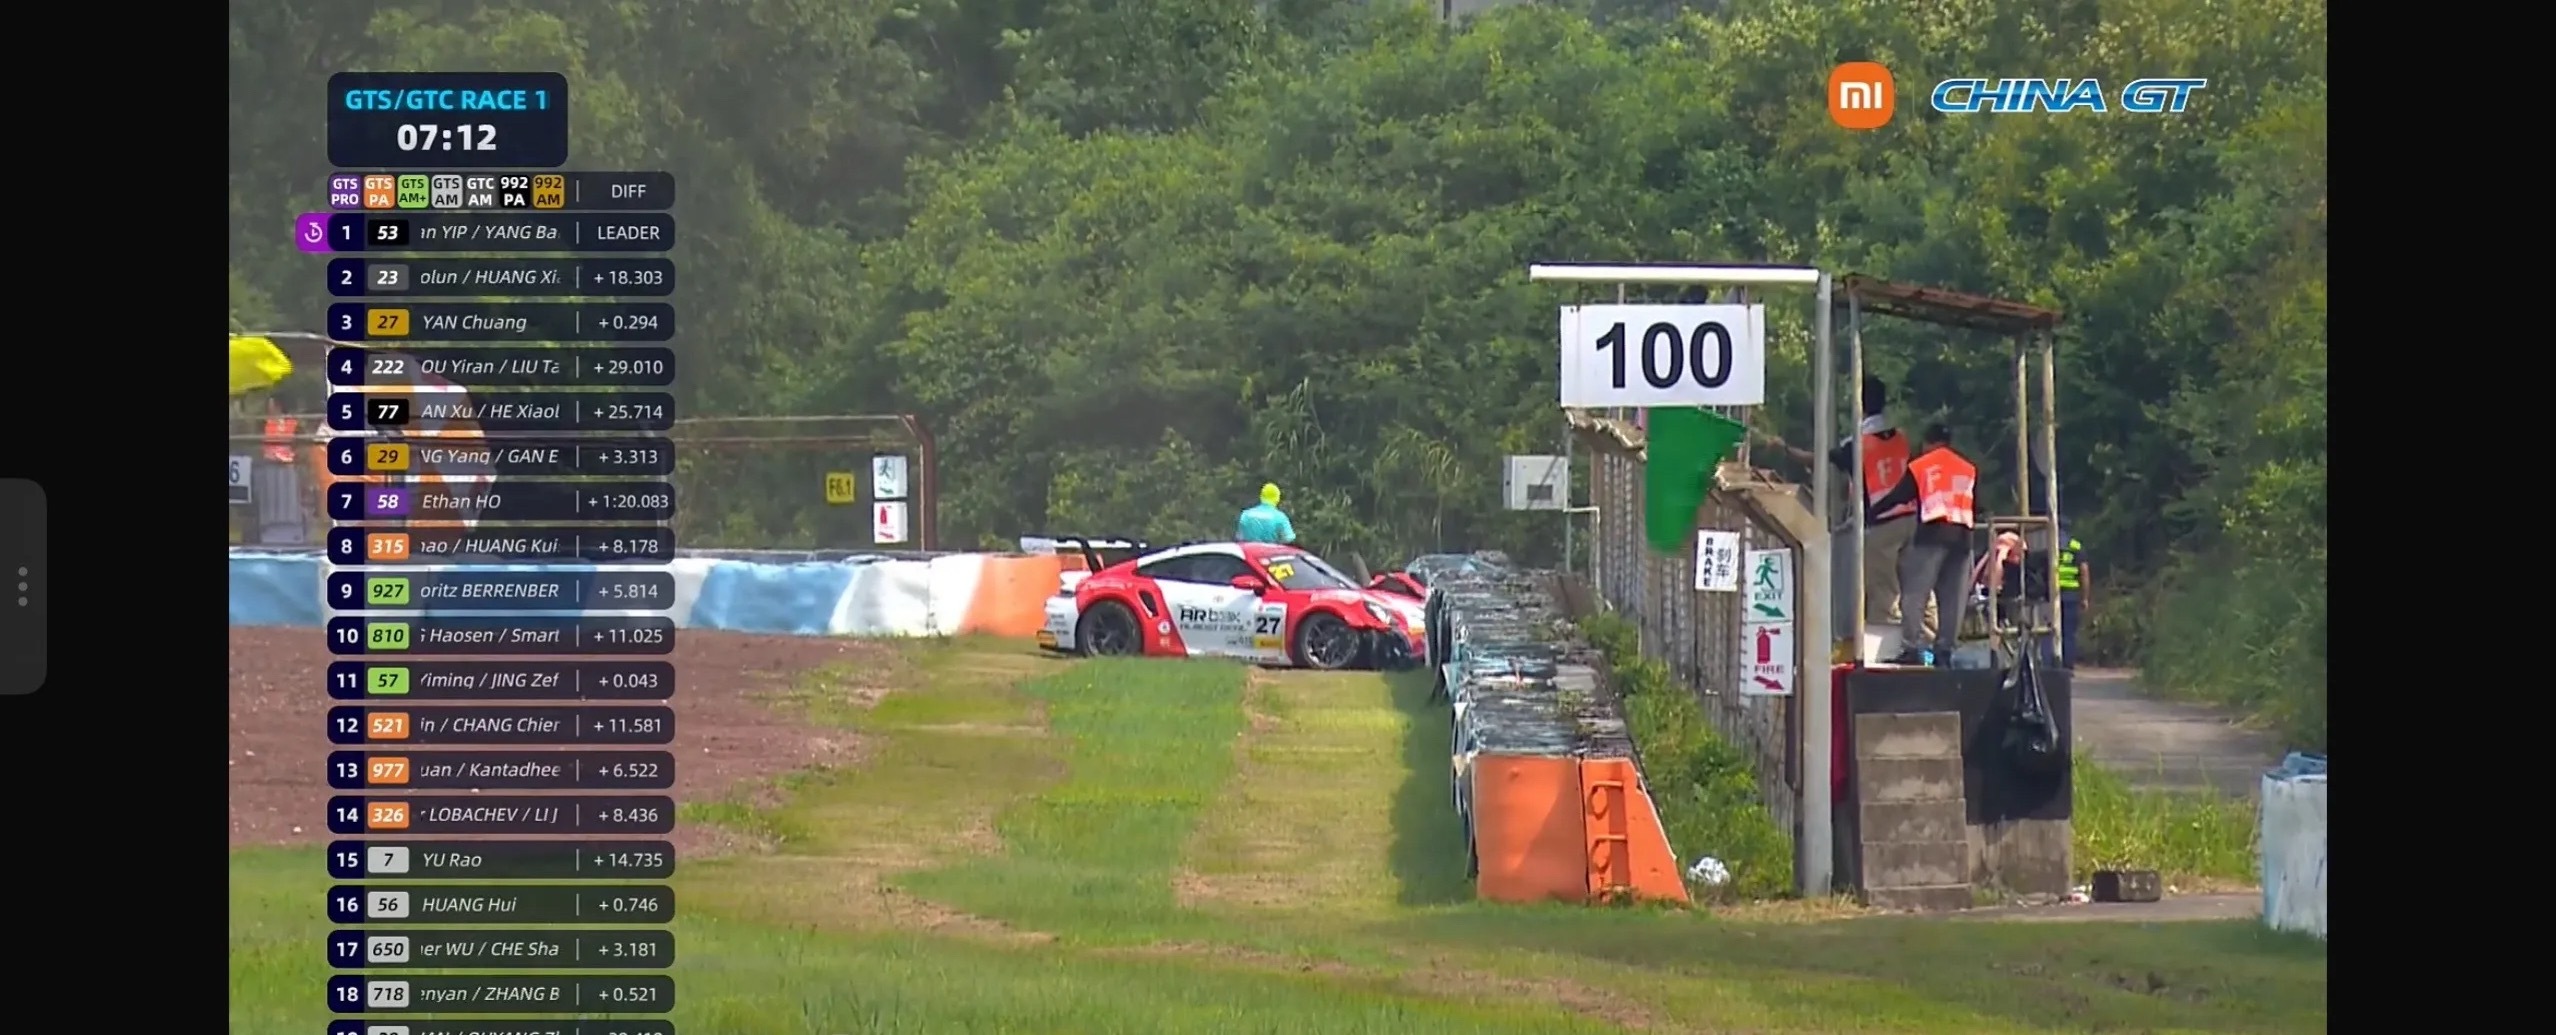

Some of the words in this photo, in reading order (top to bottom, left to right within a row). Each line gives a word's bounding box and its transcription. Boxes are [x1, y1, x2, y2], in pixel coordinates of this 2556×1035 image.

[1596, 321, 1733, 389] 100
[1923, 464, 1942, 496] F
[1703, 537, 1714, 587] BRAKE
[1754, 592, 1783, 601] EXIT
[1255, 617, 1281, 635] 27
[1754, 664, 1785, 675] FIRE
